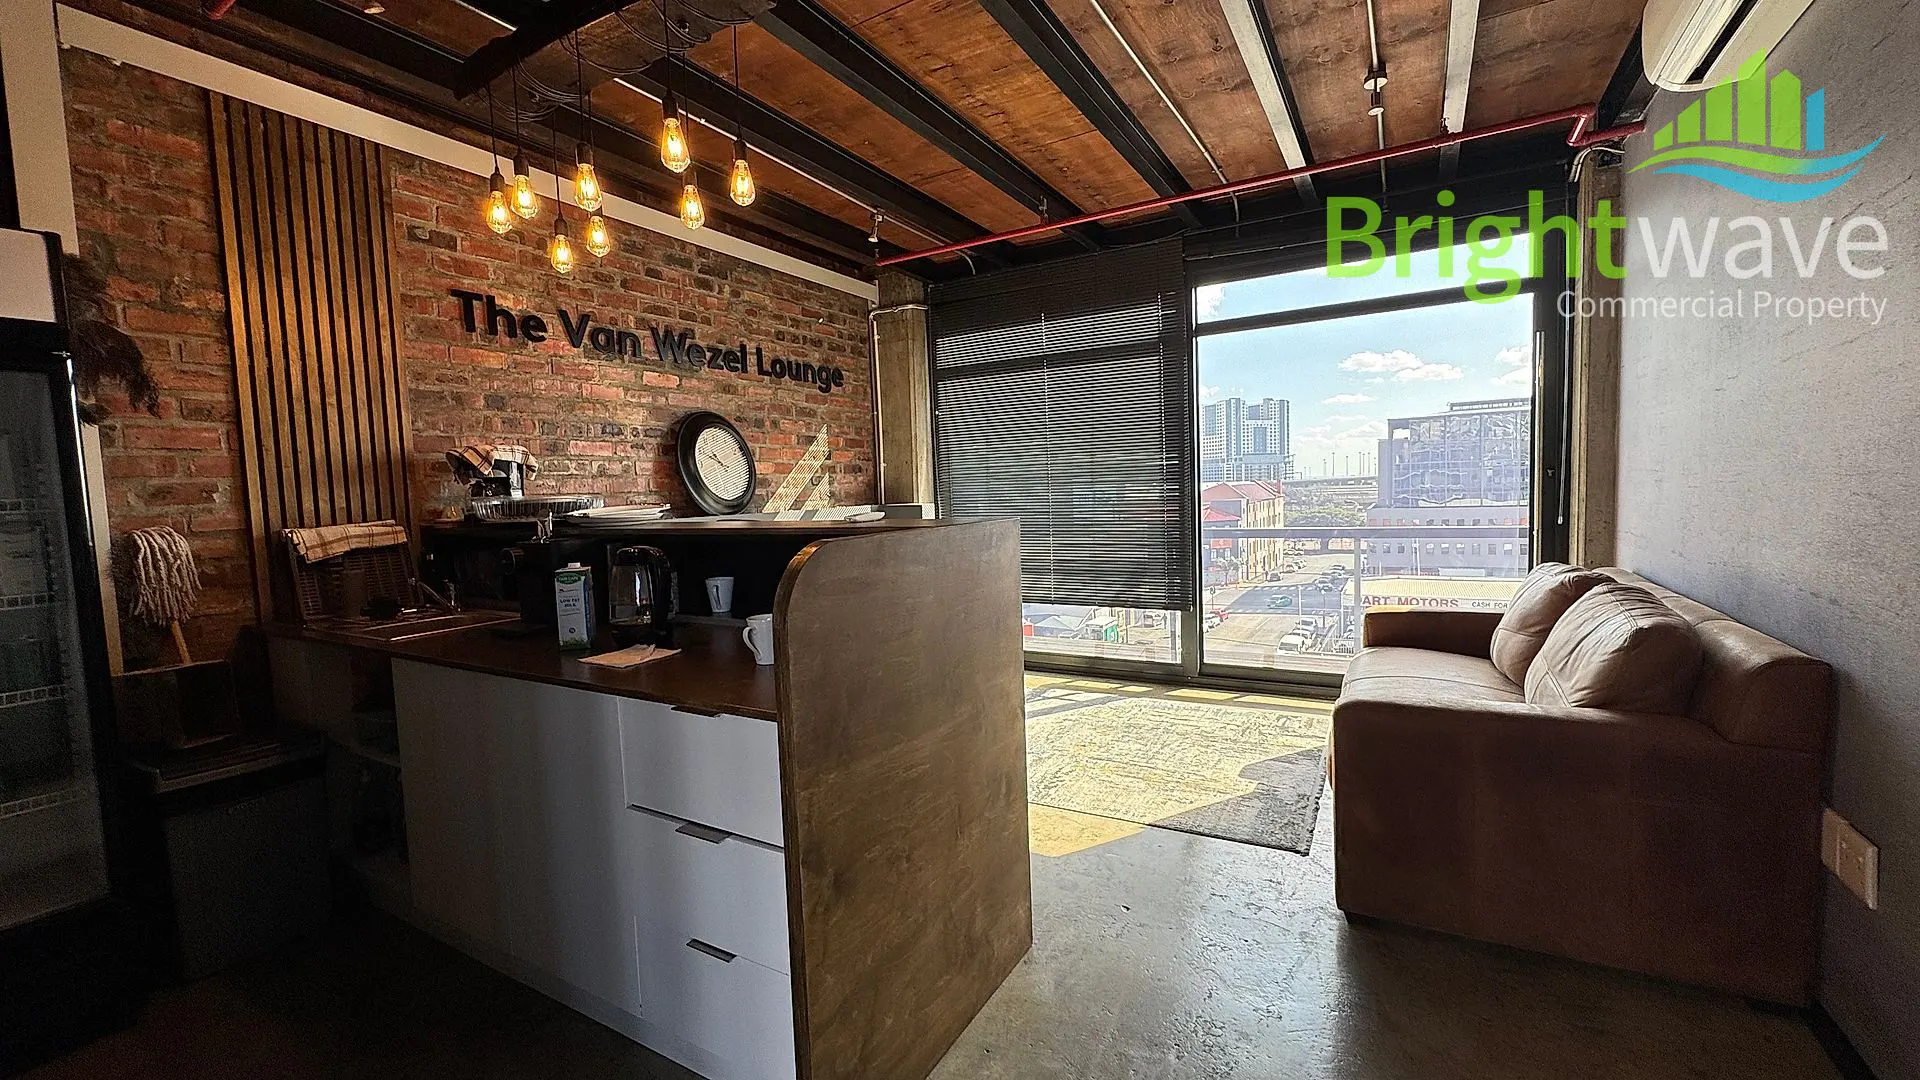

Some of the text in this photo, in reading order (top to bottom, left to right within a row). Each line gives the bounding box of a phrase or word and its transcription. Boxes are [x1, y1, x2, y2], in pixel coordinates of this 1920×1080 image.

[450, 289, 846, 394] The Van Wezel Lounge
[1397, 597, 1459, 608] MOTORS
[1471, 601, 1491, 609] CASH
